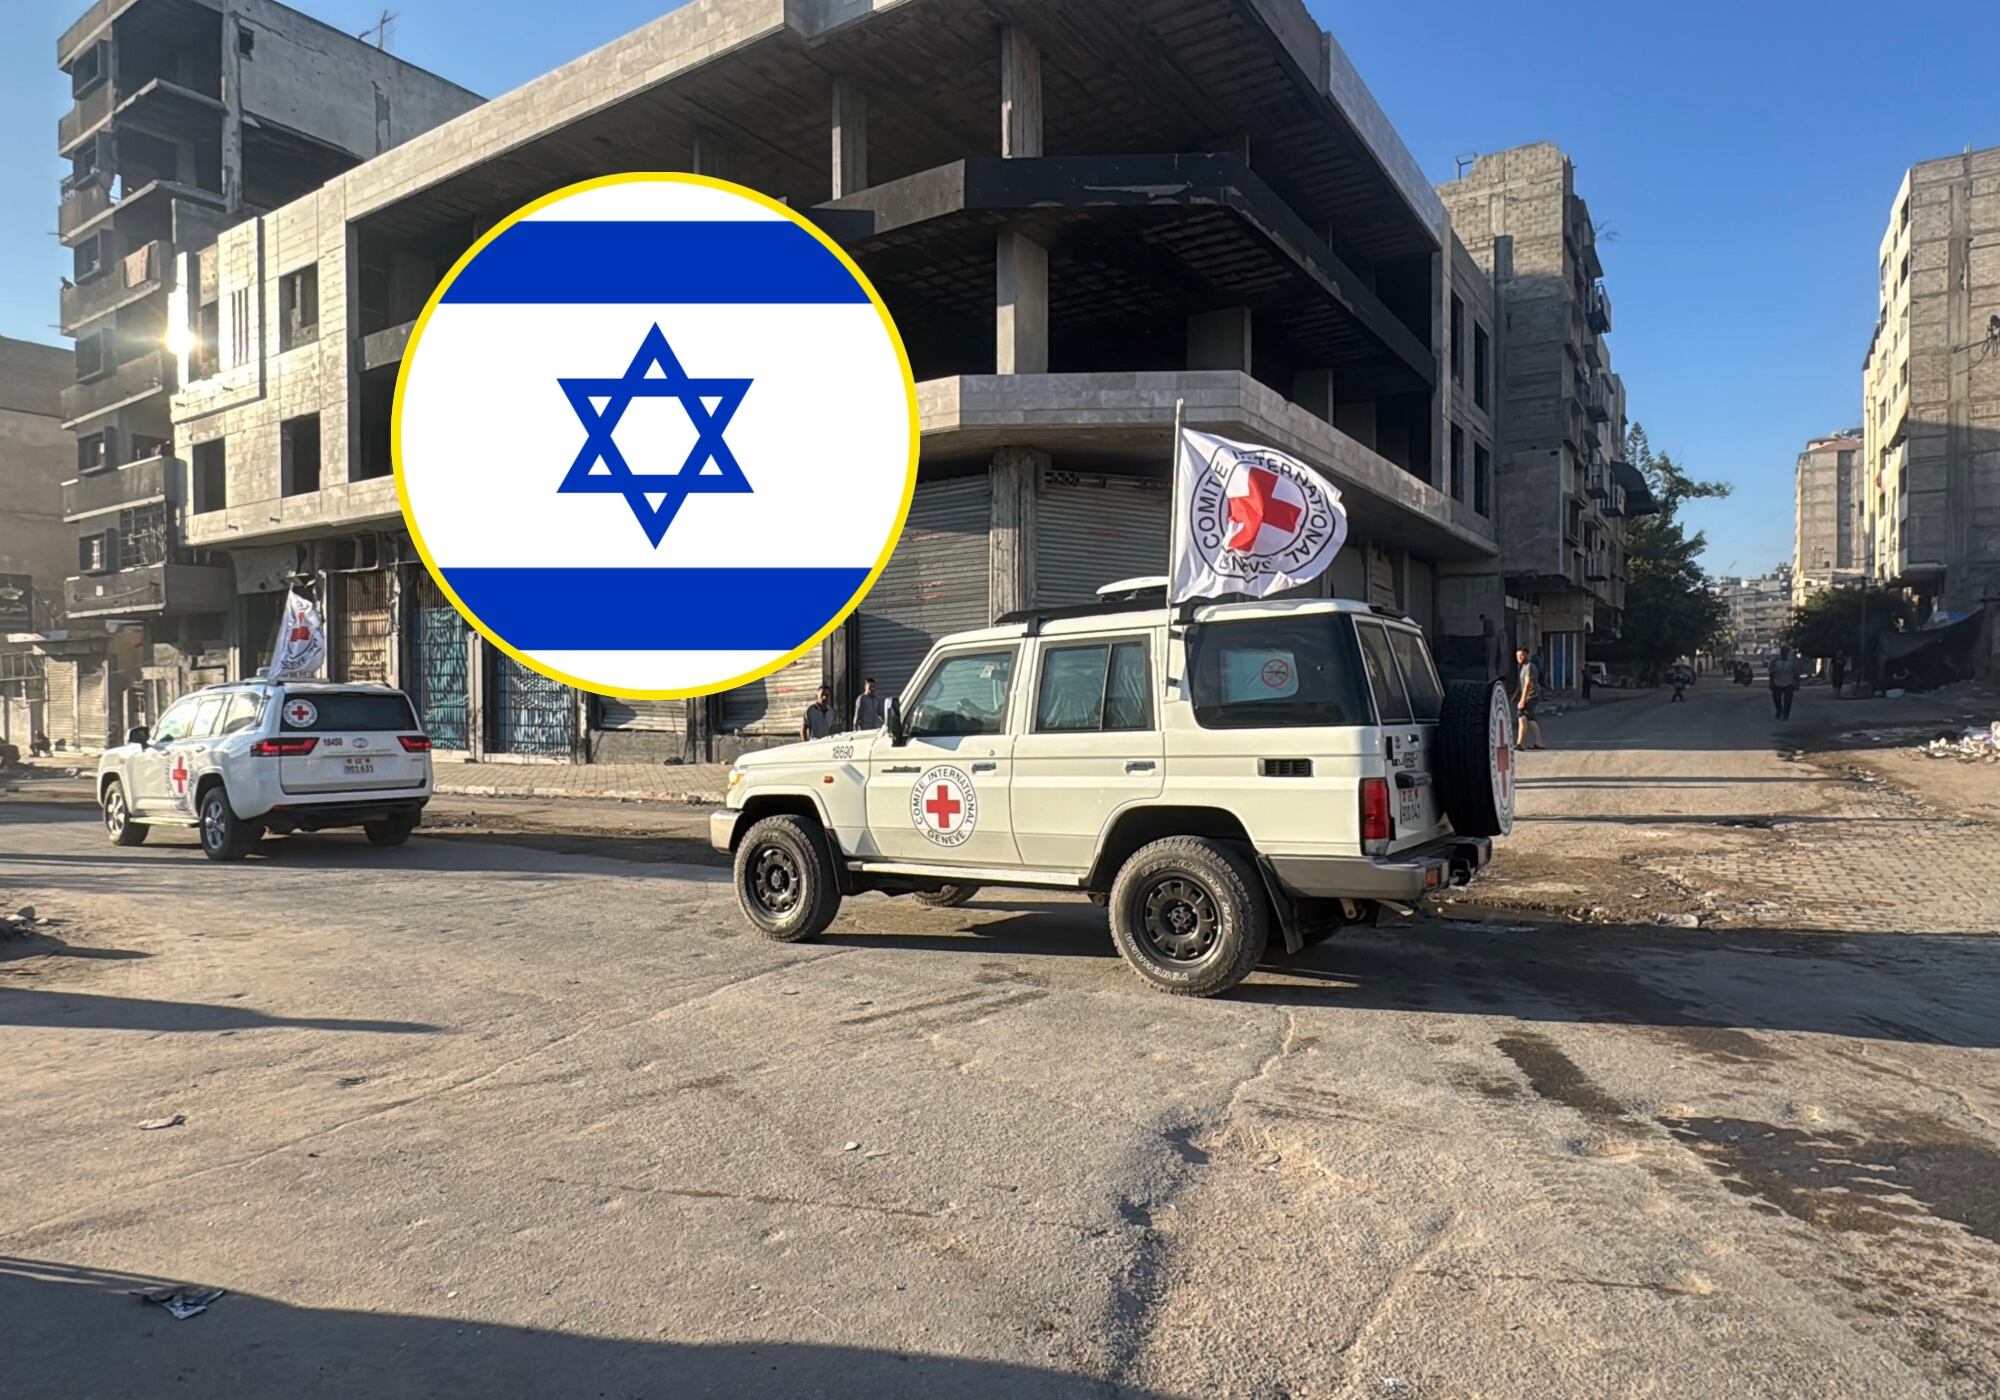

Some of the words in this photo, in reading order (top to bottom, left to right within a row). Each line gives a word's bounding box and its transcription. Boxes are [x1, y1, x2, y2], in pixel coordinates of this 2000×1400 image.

[1198, 461, 1228, 549] COMITE
[1232, 450, 1328, 563] ITERNATIONAL
[832, 745, 854, 759] 18690
[912, 780, 927, 825] COMITE
[927, 768, 975, 824] INTERNATIONAL
[927, 829, 966, 845] GENEVE
